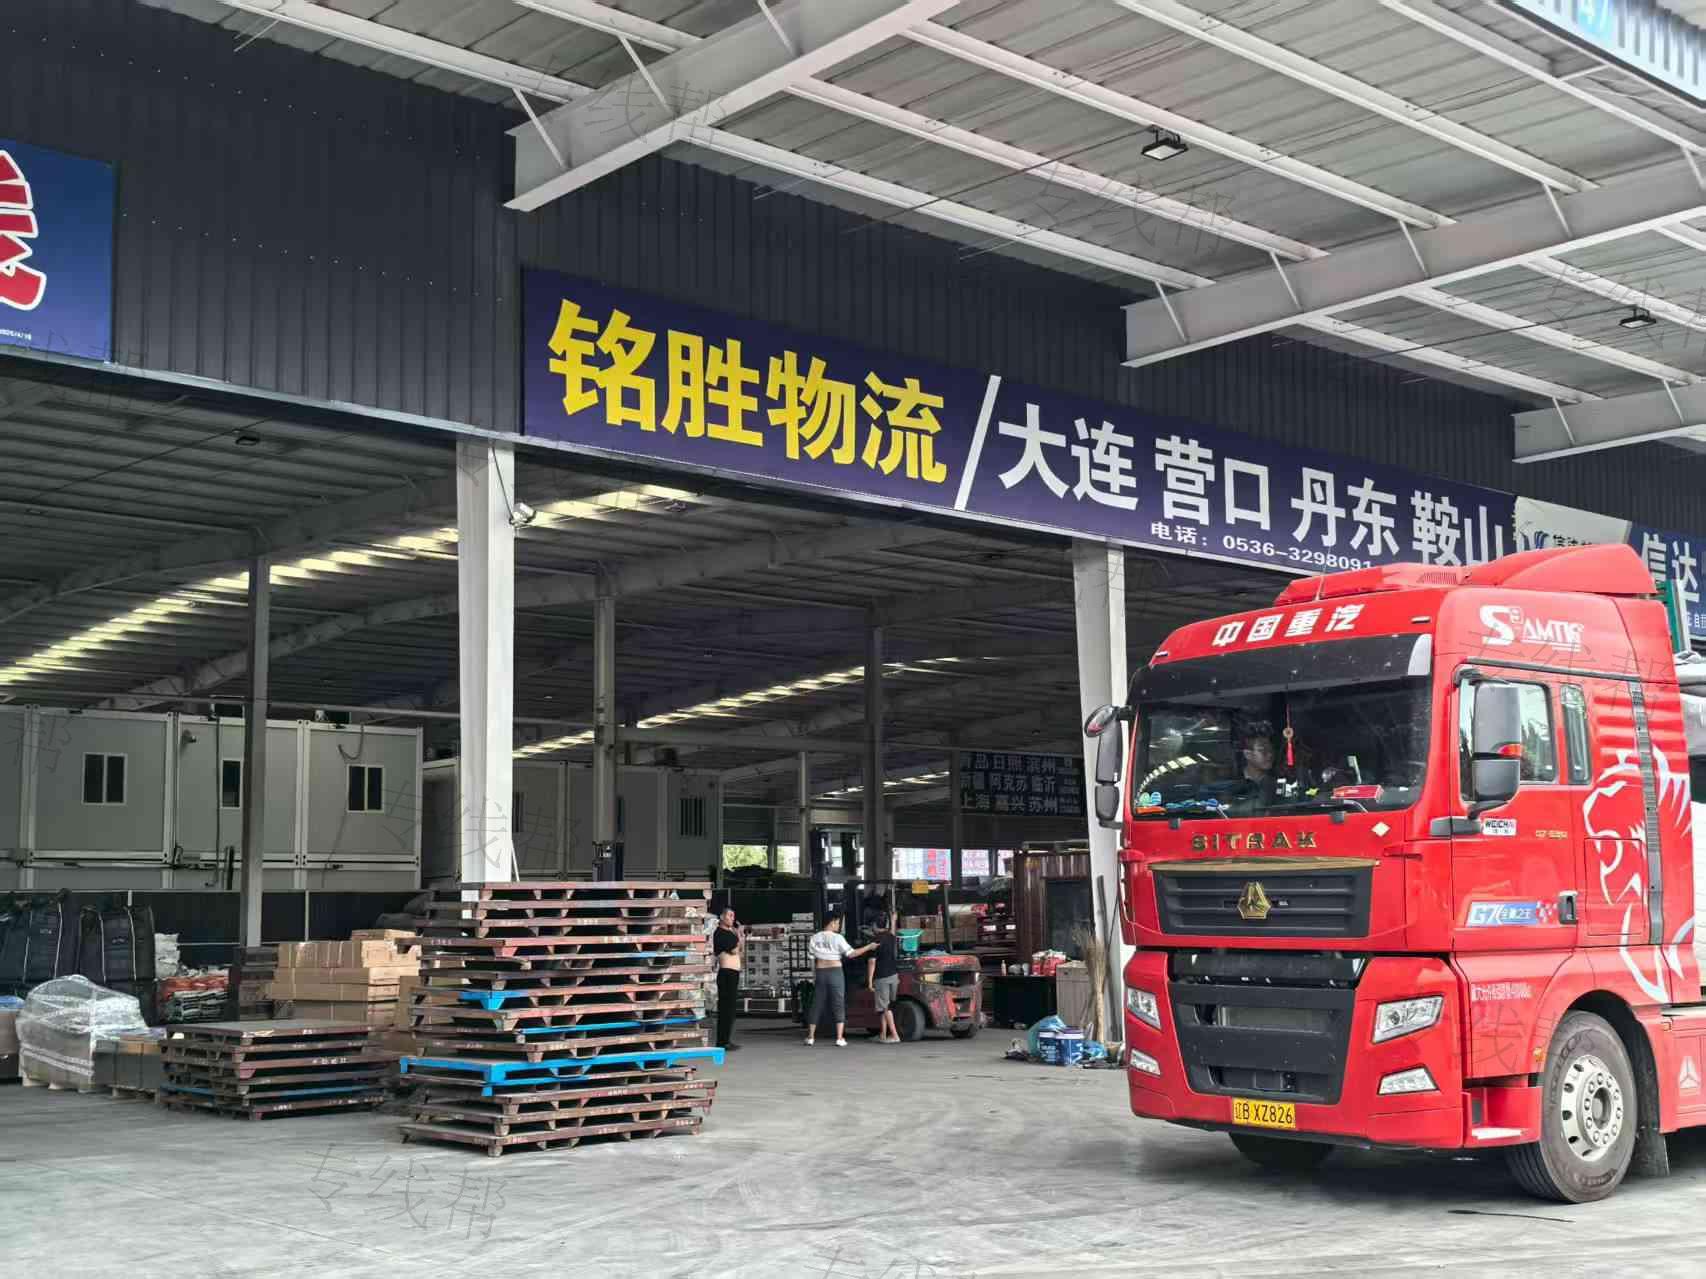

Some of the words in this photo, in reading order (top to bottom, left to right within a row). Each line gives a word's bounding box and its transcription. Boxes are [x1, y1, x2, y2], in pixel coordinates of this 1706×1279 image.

[548, 298, 947, 484] 铭胜物流
[997, 403, 1139, 512] 大连
[1155, 435, 1271, 531] 营口
[1291, 467, 1398, 557] 丹东
[1411, 490, 1504, 567] 鞍山
[1211, 603, 1365, 648] 中国重汽
[1191, 831, 1318, 852] SITRAK
[1254, 1103, 1293, 1125] XZ826
